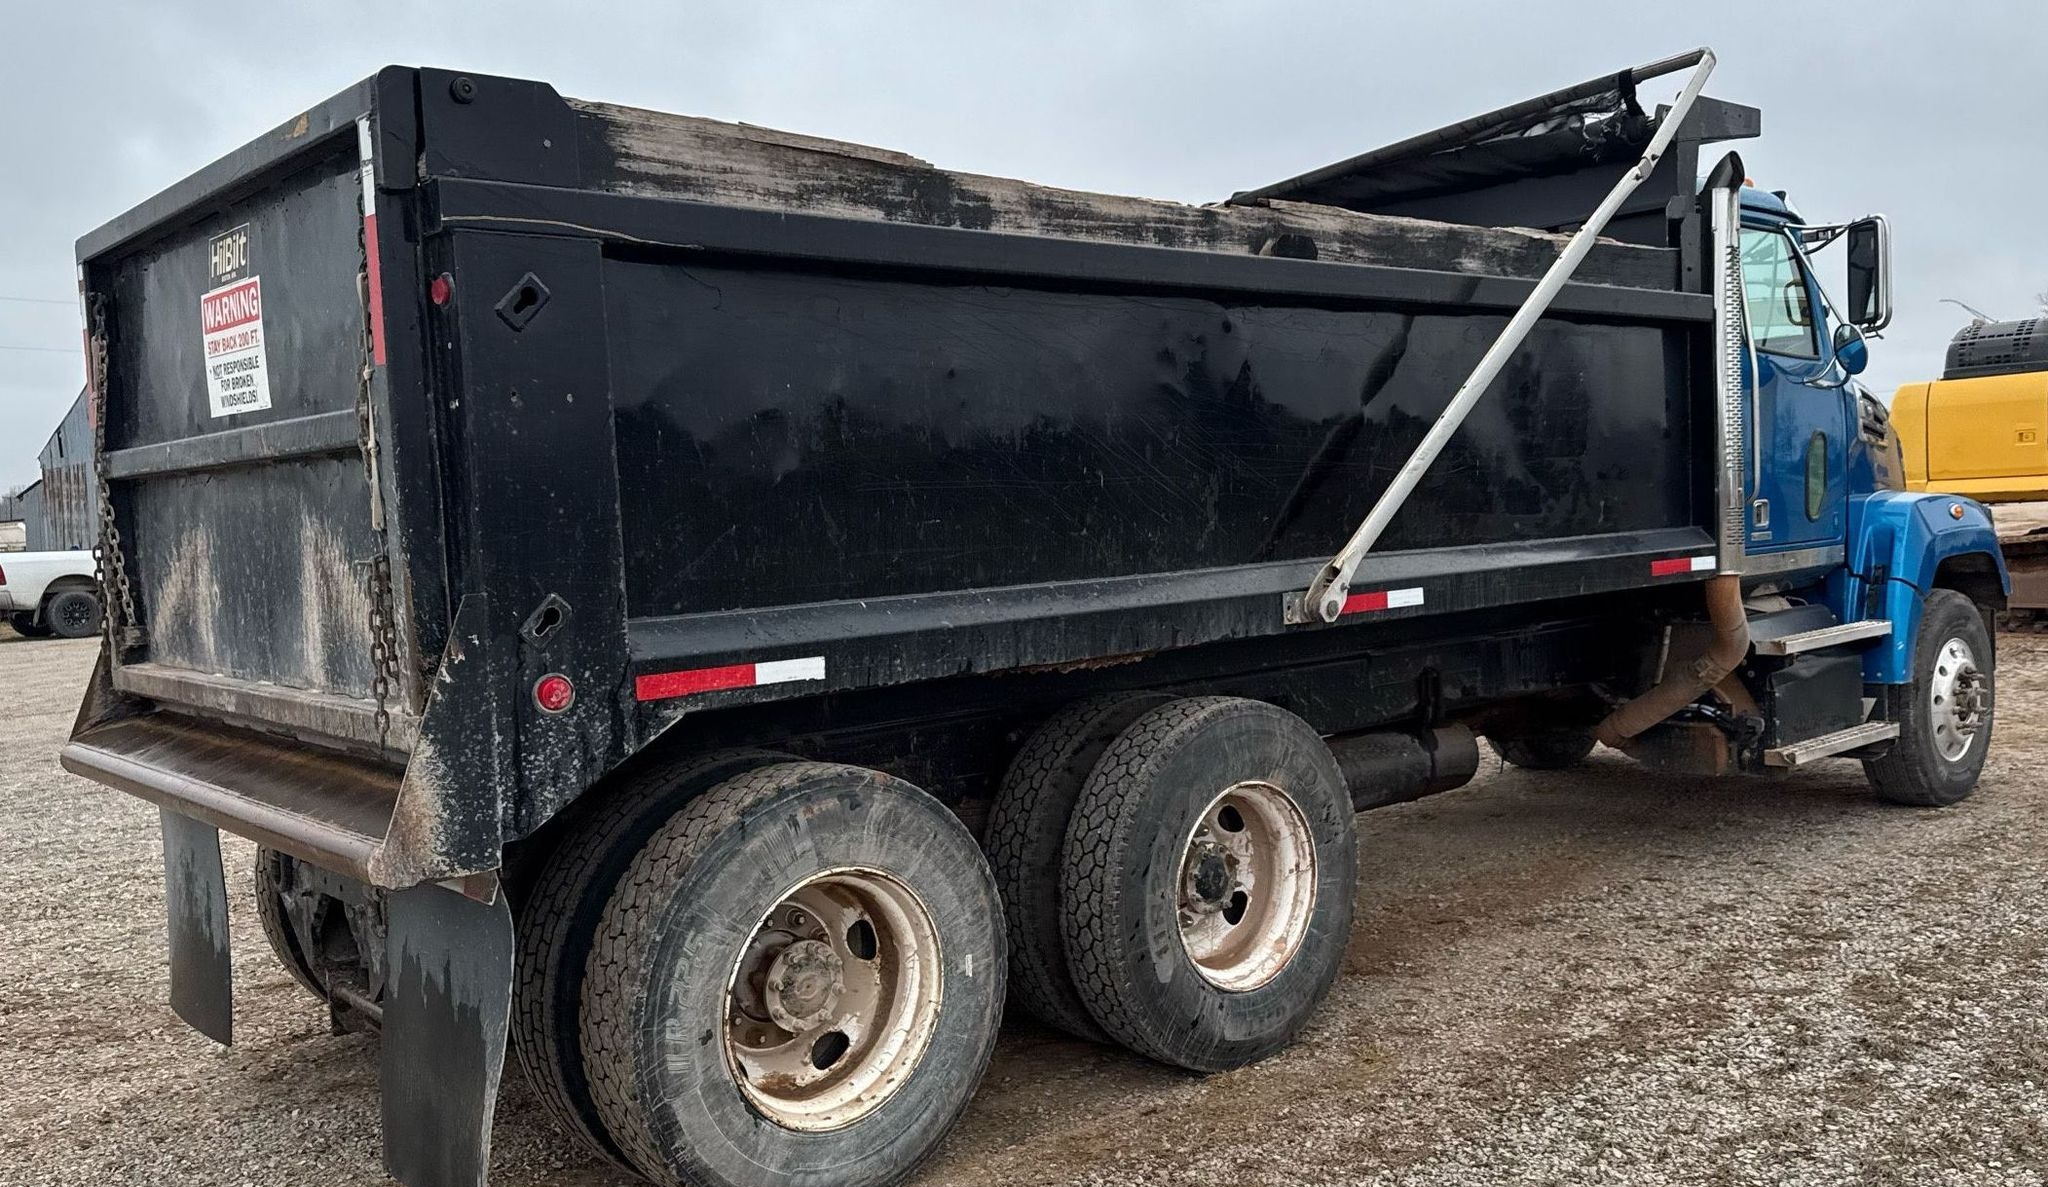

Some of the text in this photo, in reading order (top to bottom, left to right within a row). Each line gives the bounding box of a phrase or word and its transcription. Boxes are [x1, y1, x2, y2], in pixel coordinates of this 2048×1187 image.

[211, 231, 247, 278] HilBilt
[204, 287, 258, 330] WARNING
[207, 329, 260, 356] STAY BACK 200 FT.
[212, 355, 260, 378] NOT RESPONSIBLE
[221, 373, 254, 392] FOR BROKEN
